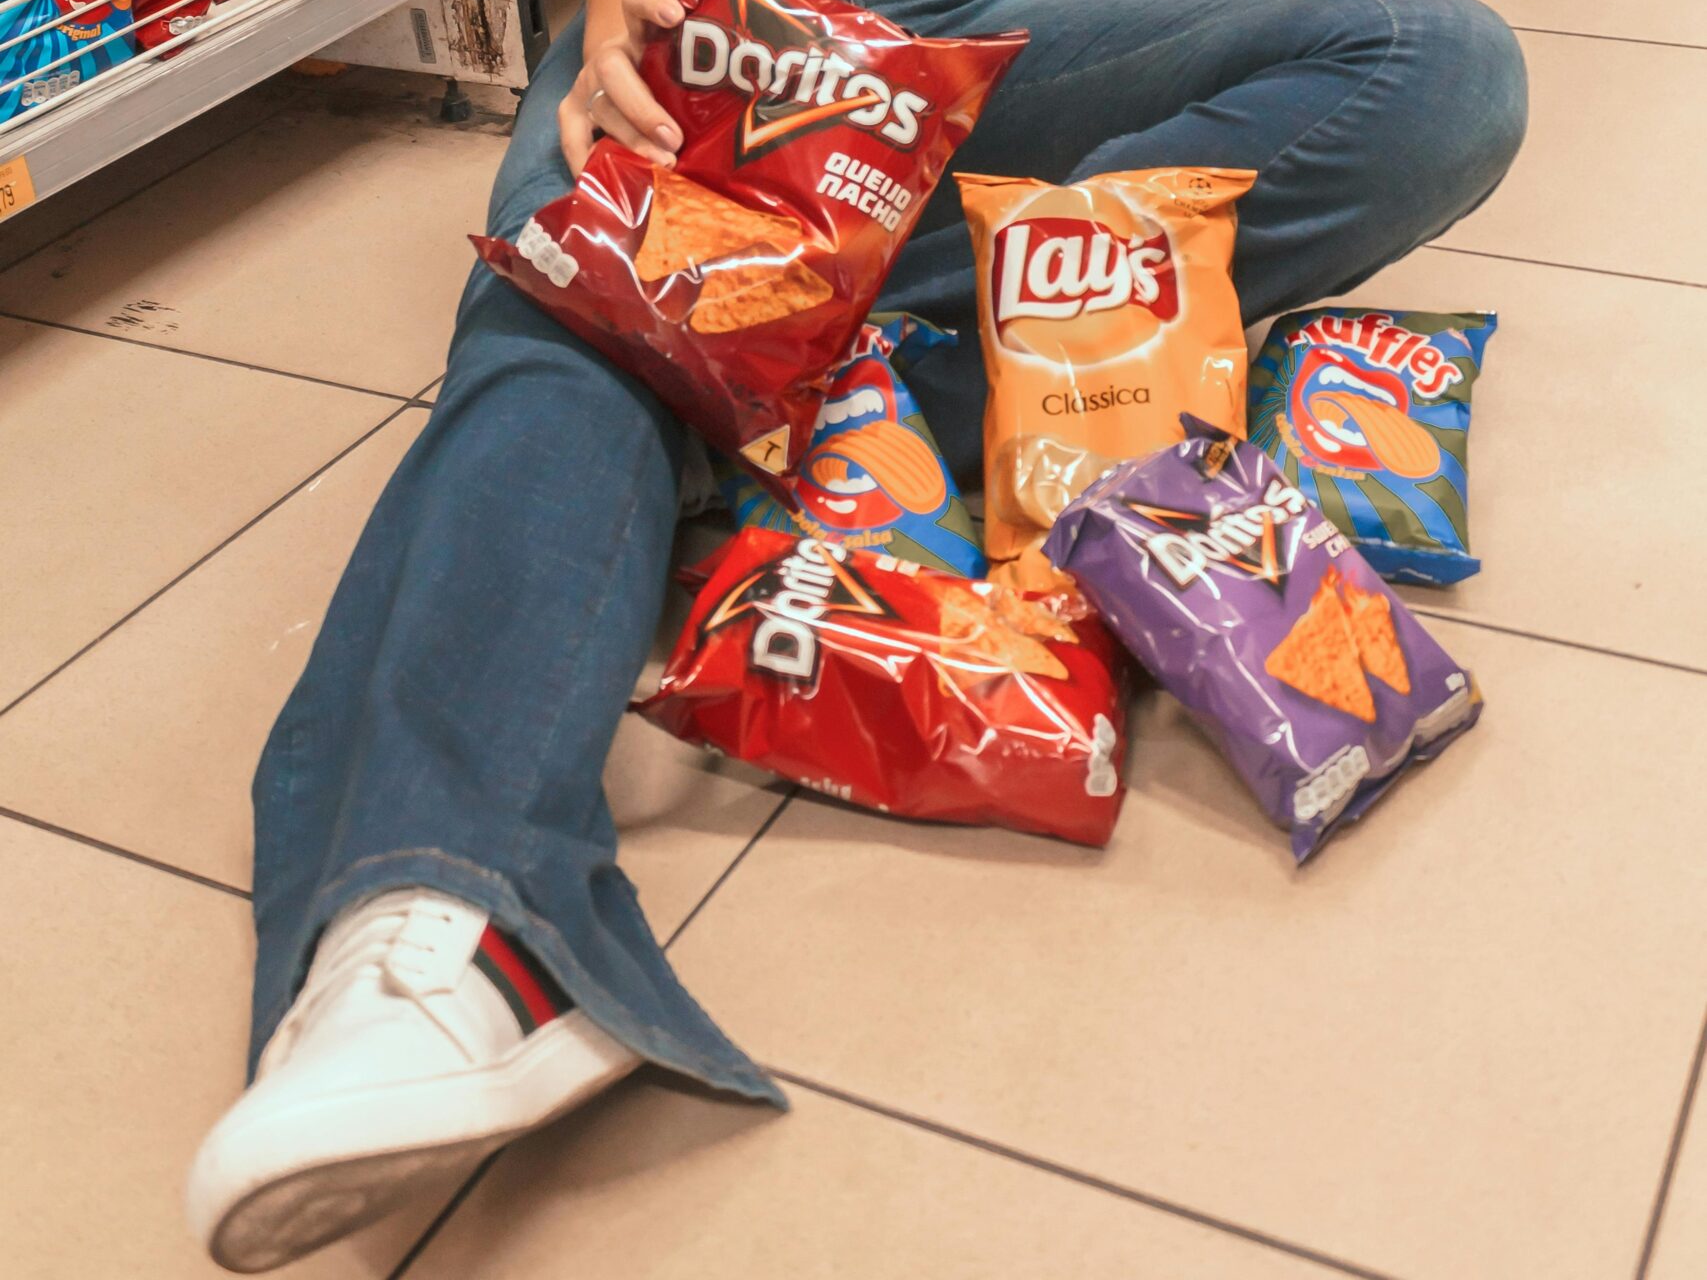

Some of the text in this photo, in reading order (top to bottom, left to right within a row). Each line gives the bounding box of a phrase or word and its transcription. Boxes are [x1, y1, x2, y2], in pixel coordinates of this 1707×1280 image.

[680, 19, 928, 146] Doritos
[816, 173, 901, 233] NACHO
[823, 151, 912, 211] QUEIJO
[998, 224, 1167, 322] Lay's
[1146, 478, 1306, 588] Doritos
